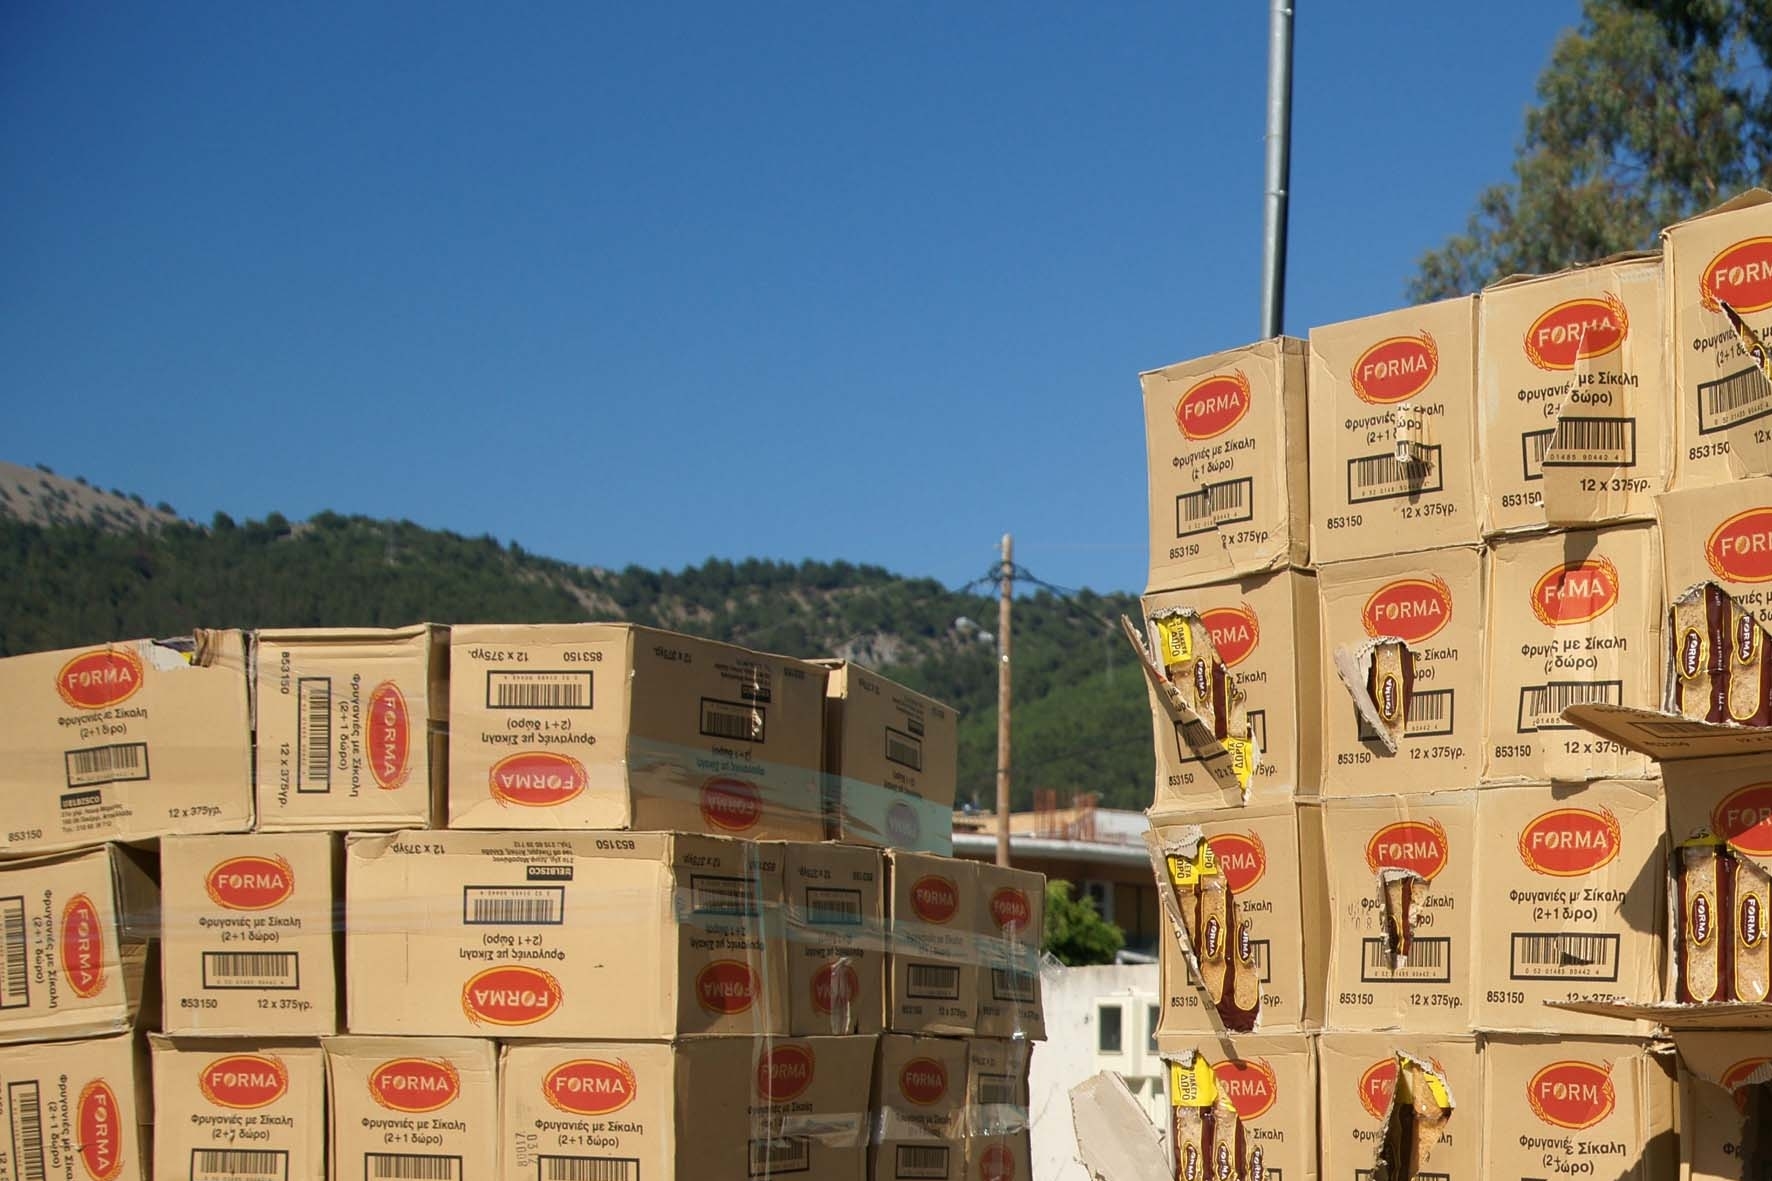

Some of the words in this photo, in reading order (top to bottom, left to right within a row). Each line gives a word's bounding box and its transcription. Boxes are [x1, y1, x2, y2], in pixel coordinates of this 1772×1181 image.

[1363, 360, 1428, 382] FORMA
[1184, 391, 1240, 419] FORMA
[1327, 515, 1362, 529] 853150
[1169, 545, 1199, 559] 853150
[1375, 600, 1441, 620] FORMA
[68, 667, 131, 689] FORMA
[383, 696, 396, 777] FORMA
[1495, 745, 1531, 758] 853150
[500, 774, 573, 790] FORMA
[1533, 830, 1606, 849] FORMA
[1379, 841, 1438, 861] FORMA
[218, 873, 284, 889] FORMA
[1509, 889, 1566, 905] Φρυγανιές
[1746, 899, 1756, 941] FORMA
[473, 990, 548, 1005] FORMA
[1339, 993, 1373, 1005] 853150
[382, 1076, 448, 1092] FORMA
[556, 1077, 625, 1094] FORMA
[94, 1095, 107, 1170] FORMA
